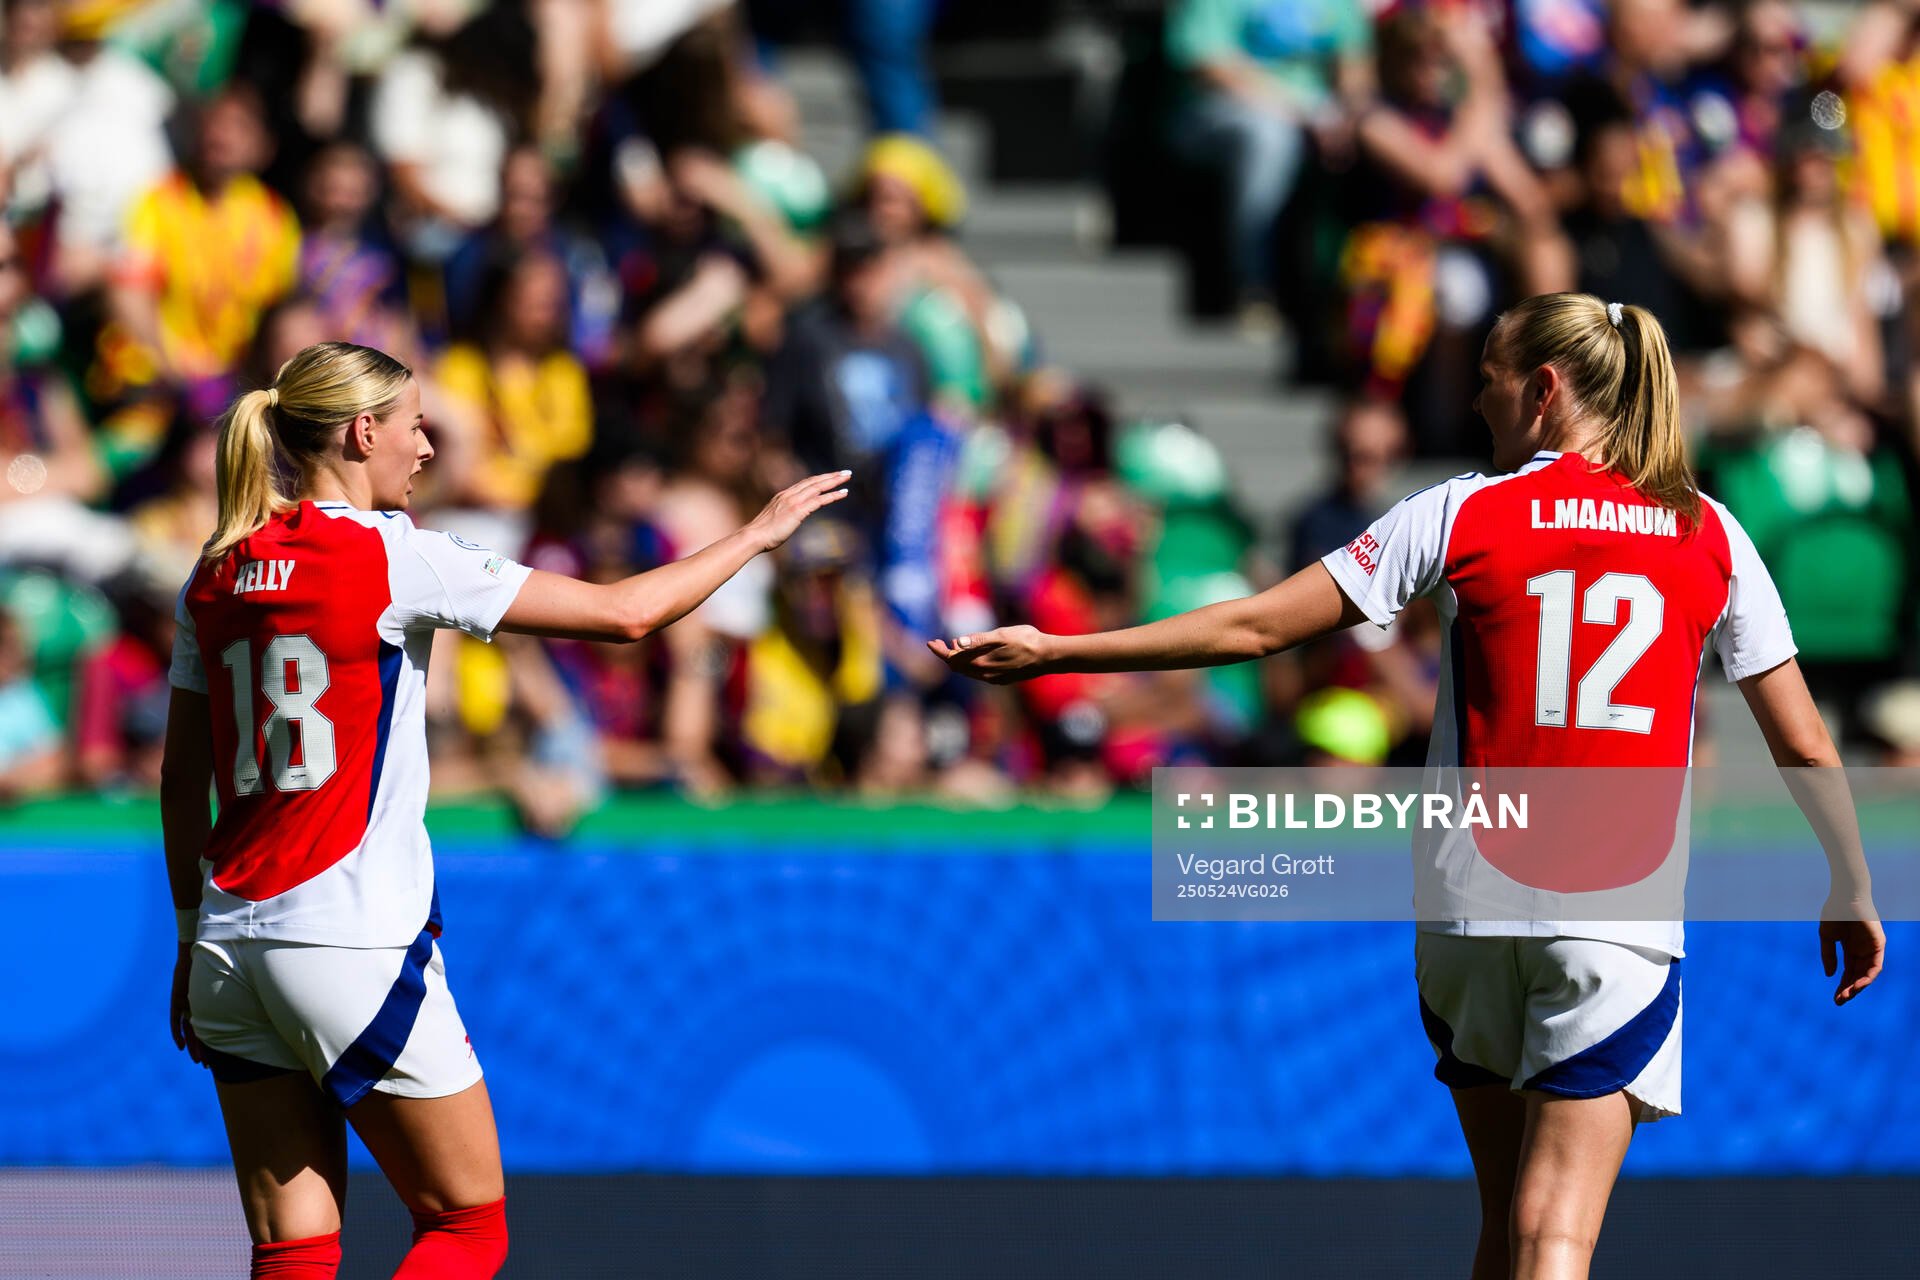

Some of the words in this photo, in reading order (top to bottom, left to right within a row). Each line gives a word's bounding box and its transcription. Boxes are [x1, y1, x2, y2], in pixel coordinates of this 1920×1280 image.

[1531, 498, 1677, 538] L.MAANUM
[233, 559, 296, 595] KELLY
[1344, 540, 1377, 577] ANDA
[1526, 569, 1665, 735] 12
[221, 633, 338, 797] 18
